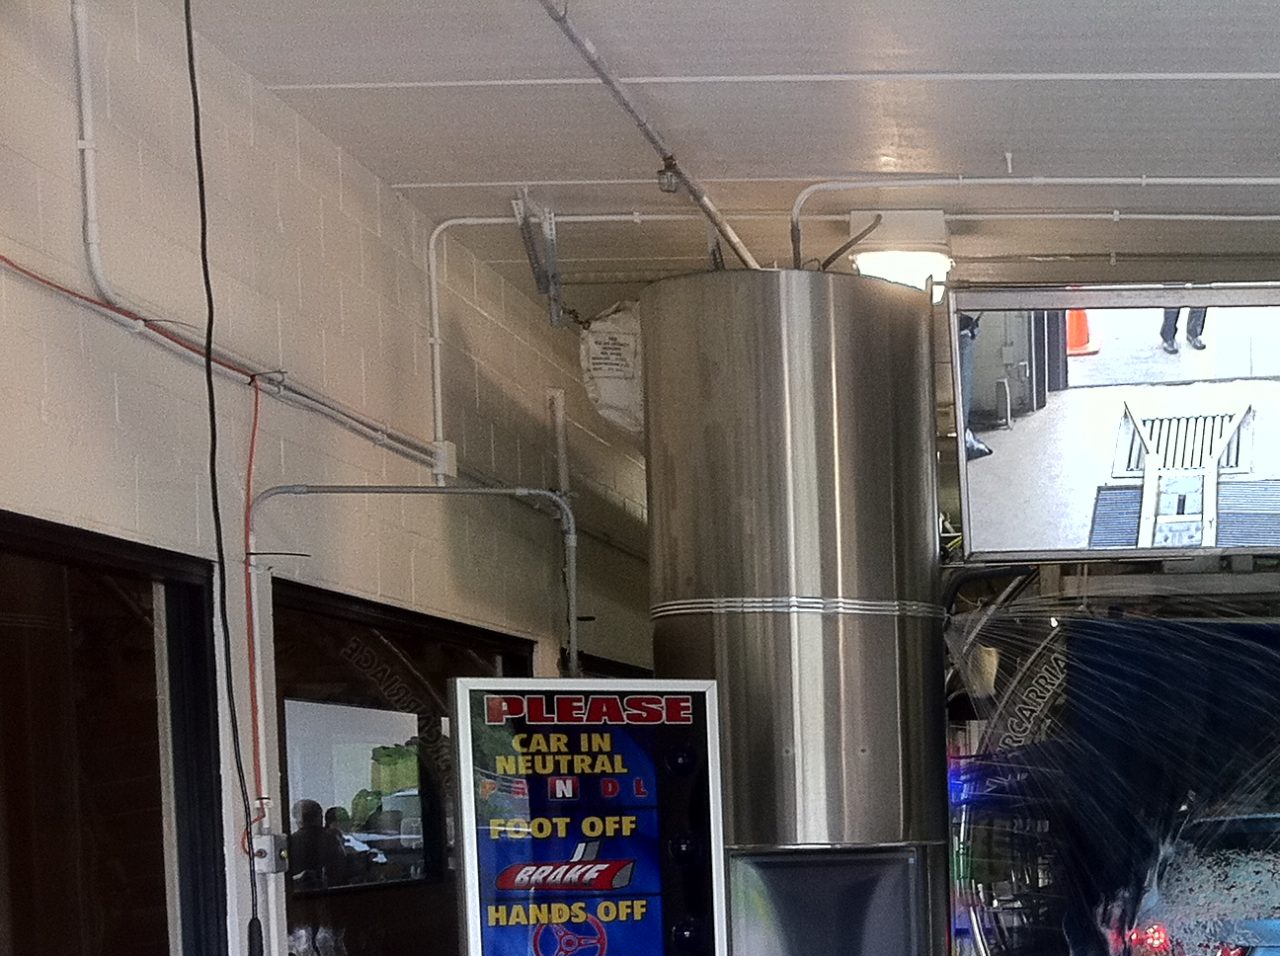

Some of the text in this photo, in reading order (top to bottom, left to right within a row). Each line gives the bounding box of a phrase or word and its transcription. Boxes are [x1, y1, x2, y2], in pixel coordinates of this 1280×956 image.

[484, 695, 693, 725] PLEASE
[511, 732, 612, 753] CAR IN
[495, 755, 627, 775] NEUTRAL
[555, 779, 573, 798] N
[602, 778, 620, 797] D
[489, 816, 637, 839] FOOT OFF
[513, 863, 609, 887] BRAKE
[487, 899, 647, 927] HANDS OFF
